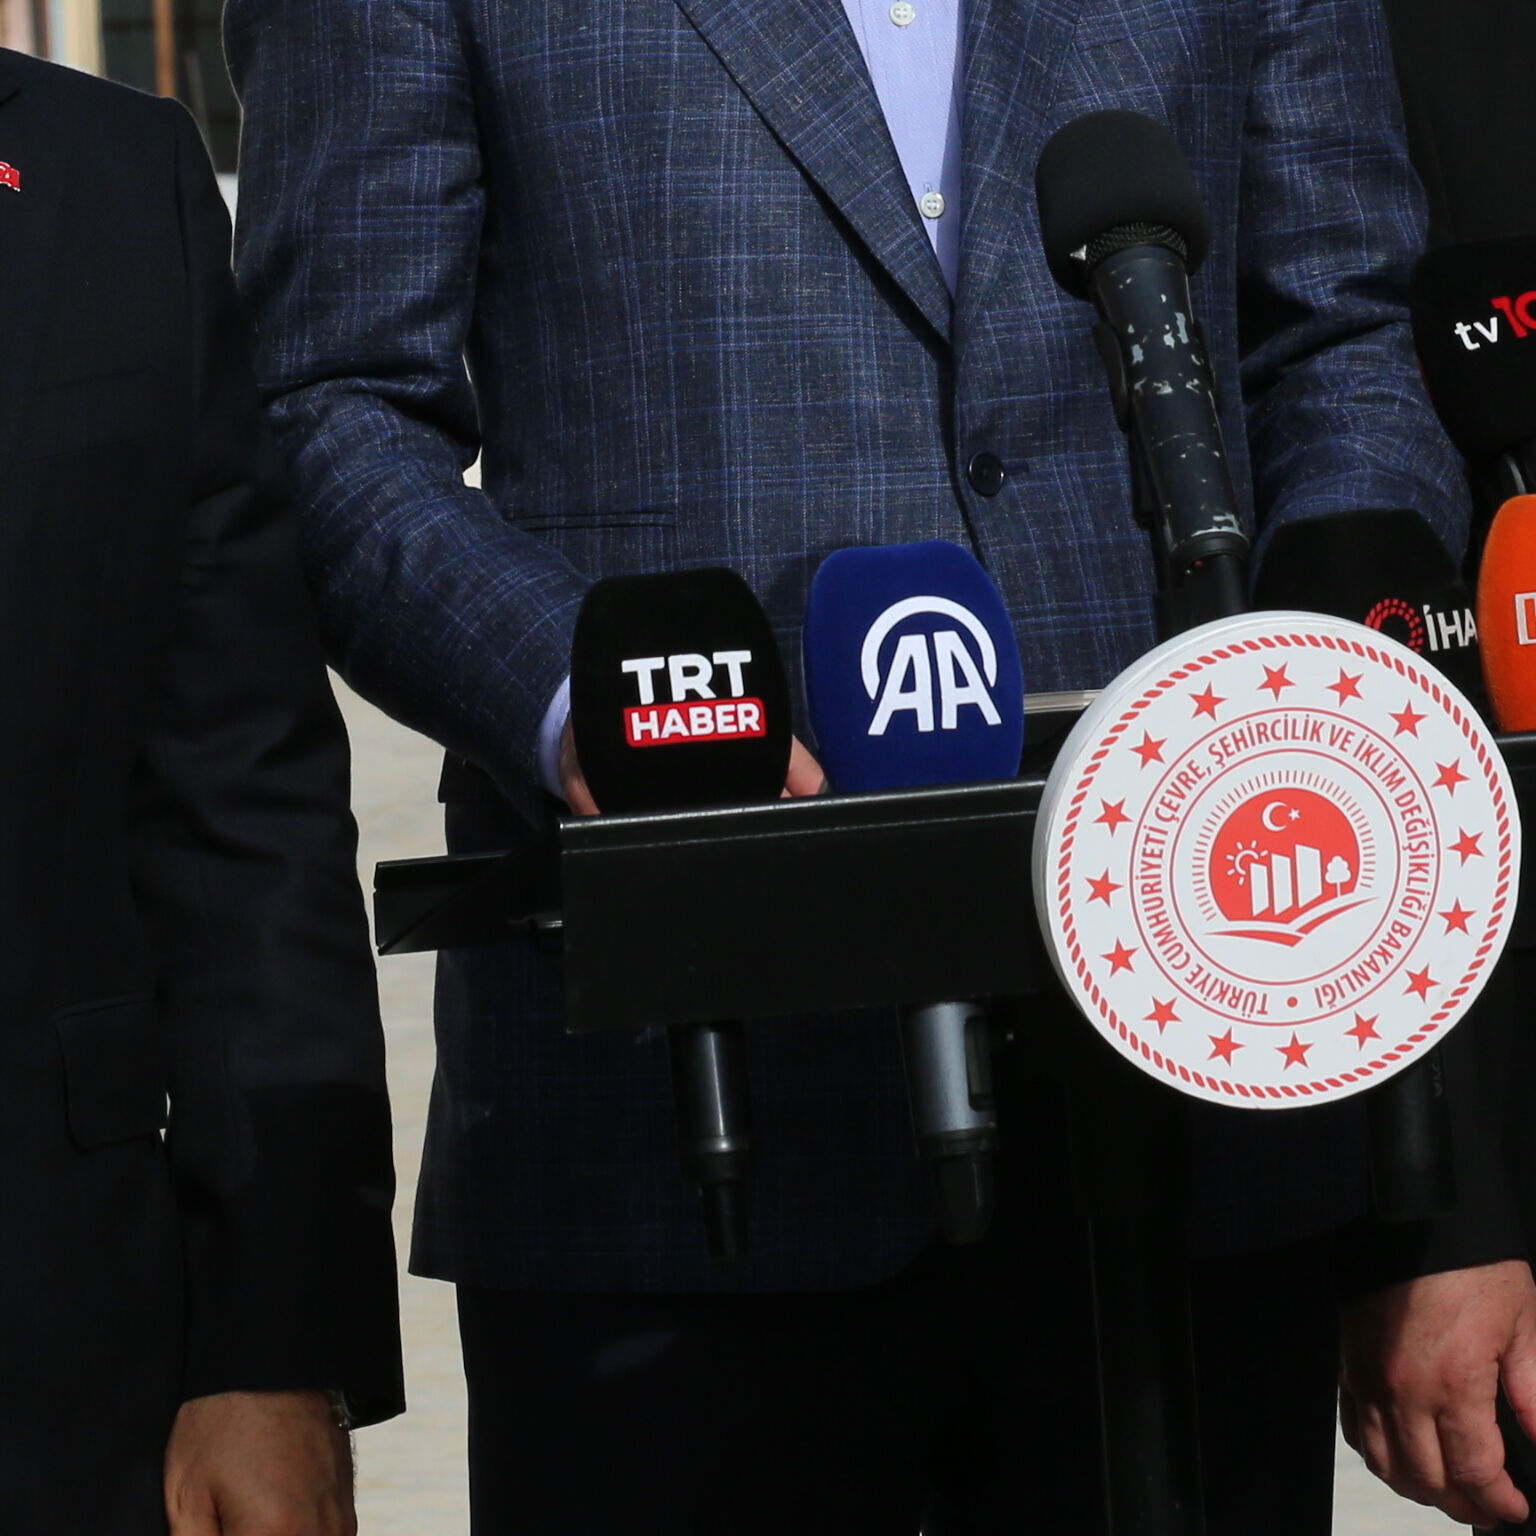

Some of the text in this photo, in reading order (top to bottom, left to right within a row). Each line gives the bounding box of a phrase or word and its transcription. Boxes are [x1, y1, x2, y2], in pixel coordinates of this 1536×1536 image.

[1423, 605, 1477, 651] İHA
[621, 650, 752, 705] TRT
[868, 631, 1002, 735] AA
[631, 702, 762, 742] HABER
[1135, 713, 1435, 1018] TÜRKİYE CUMHURİYETİ ÇEVRE, ŞEHİRCİLİK VE İKLİM DEĞİŞİKLİĞİ BAKANLIĞI
